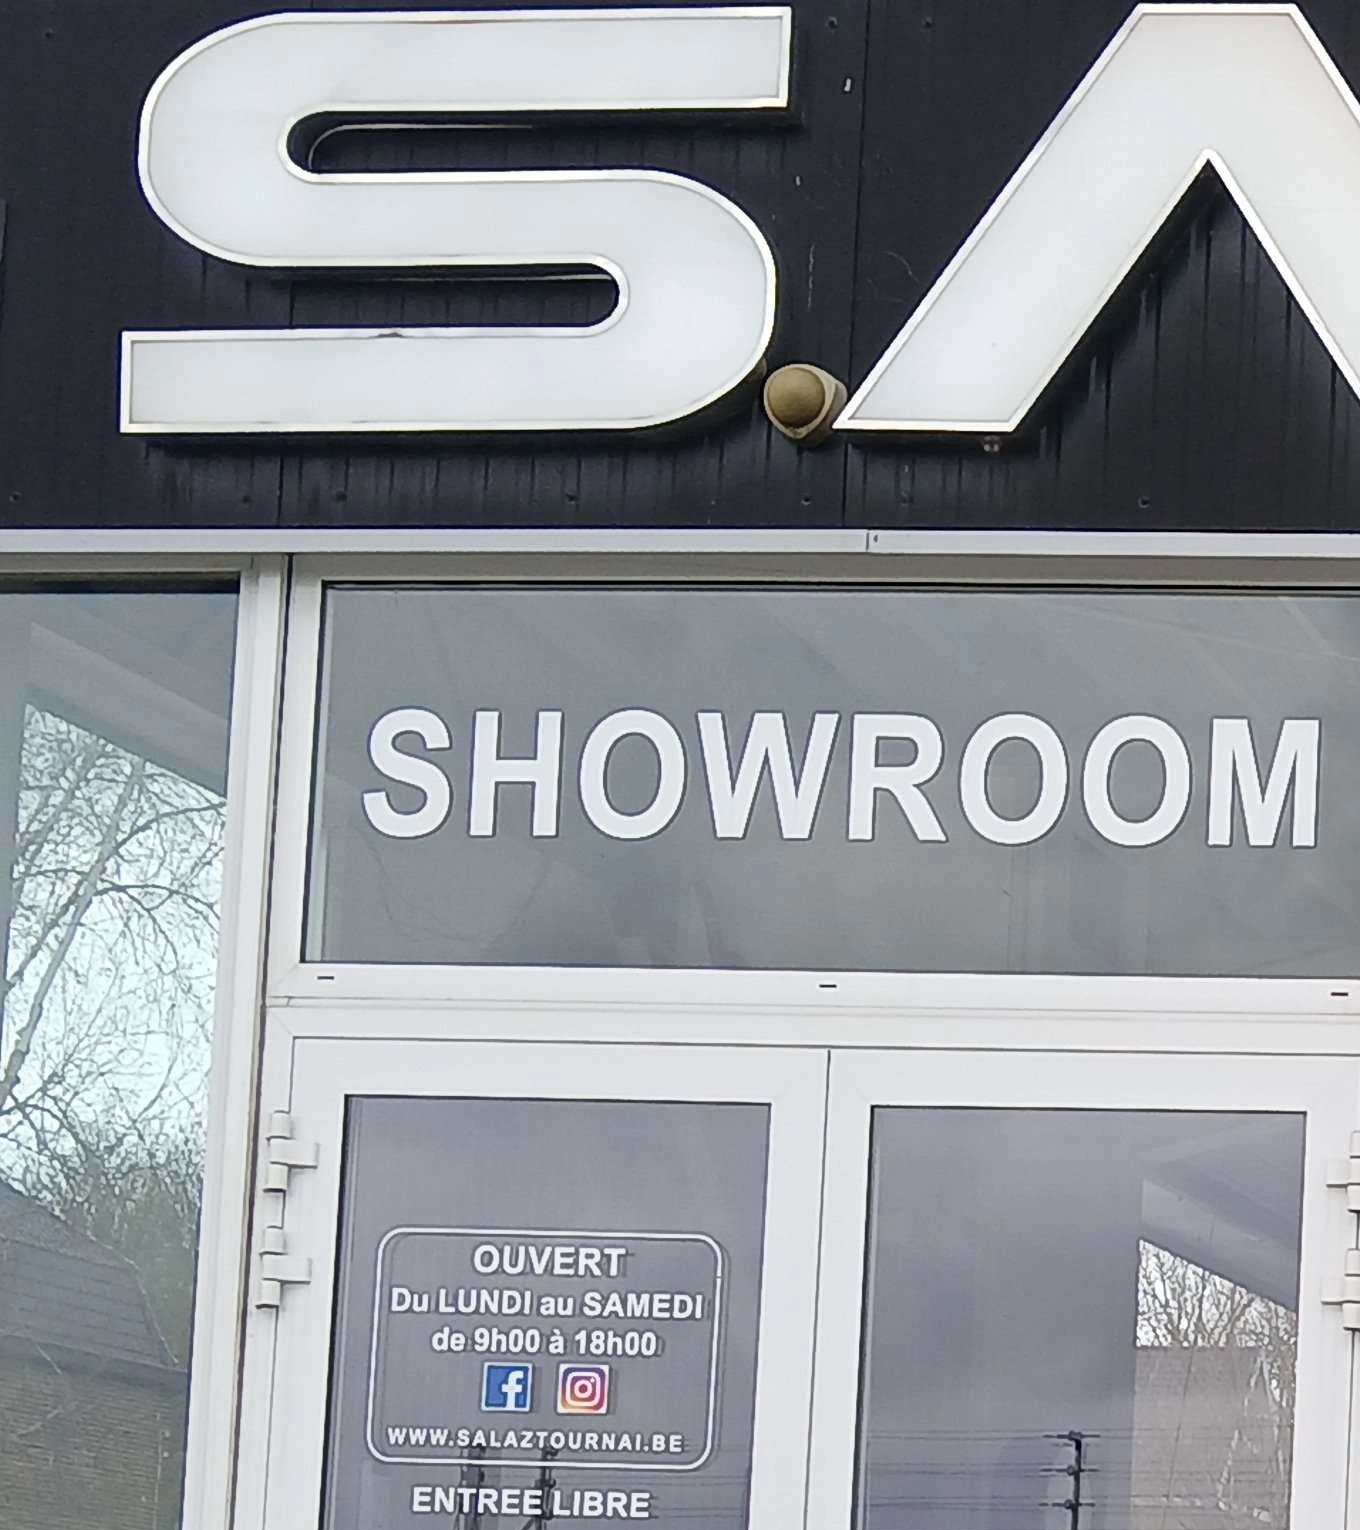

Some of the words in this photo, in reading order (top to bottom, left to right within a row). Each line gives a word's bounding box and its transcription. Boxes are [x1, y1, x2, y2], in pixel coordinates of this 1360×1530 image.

[362, 706, 1321, 850] SHOWROOM
[472, 1244, 628, 1278] OUVERT
[390, 1286, 429, 1314] Du
[438, 1288, 531, 1316] LUNDI
[538, 1294, 575, 1318] au
[582, 1291, 704, 1320] SAMEDI
[431, 1325, 468, 1353] de
[473, 1326, 541, 1354] 9h00
[547, 1328, 565, 1355] à
[573, 1330, 657, 1357] 18h00
[387, 1427, 683, 1453] WWW.SALAZTOURNAI.BE
[411, 1485, 543, 1517] ENTREE
[551, 1489, 651, 1519] LIBRE
